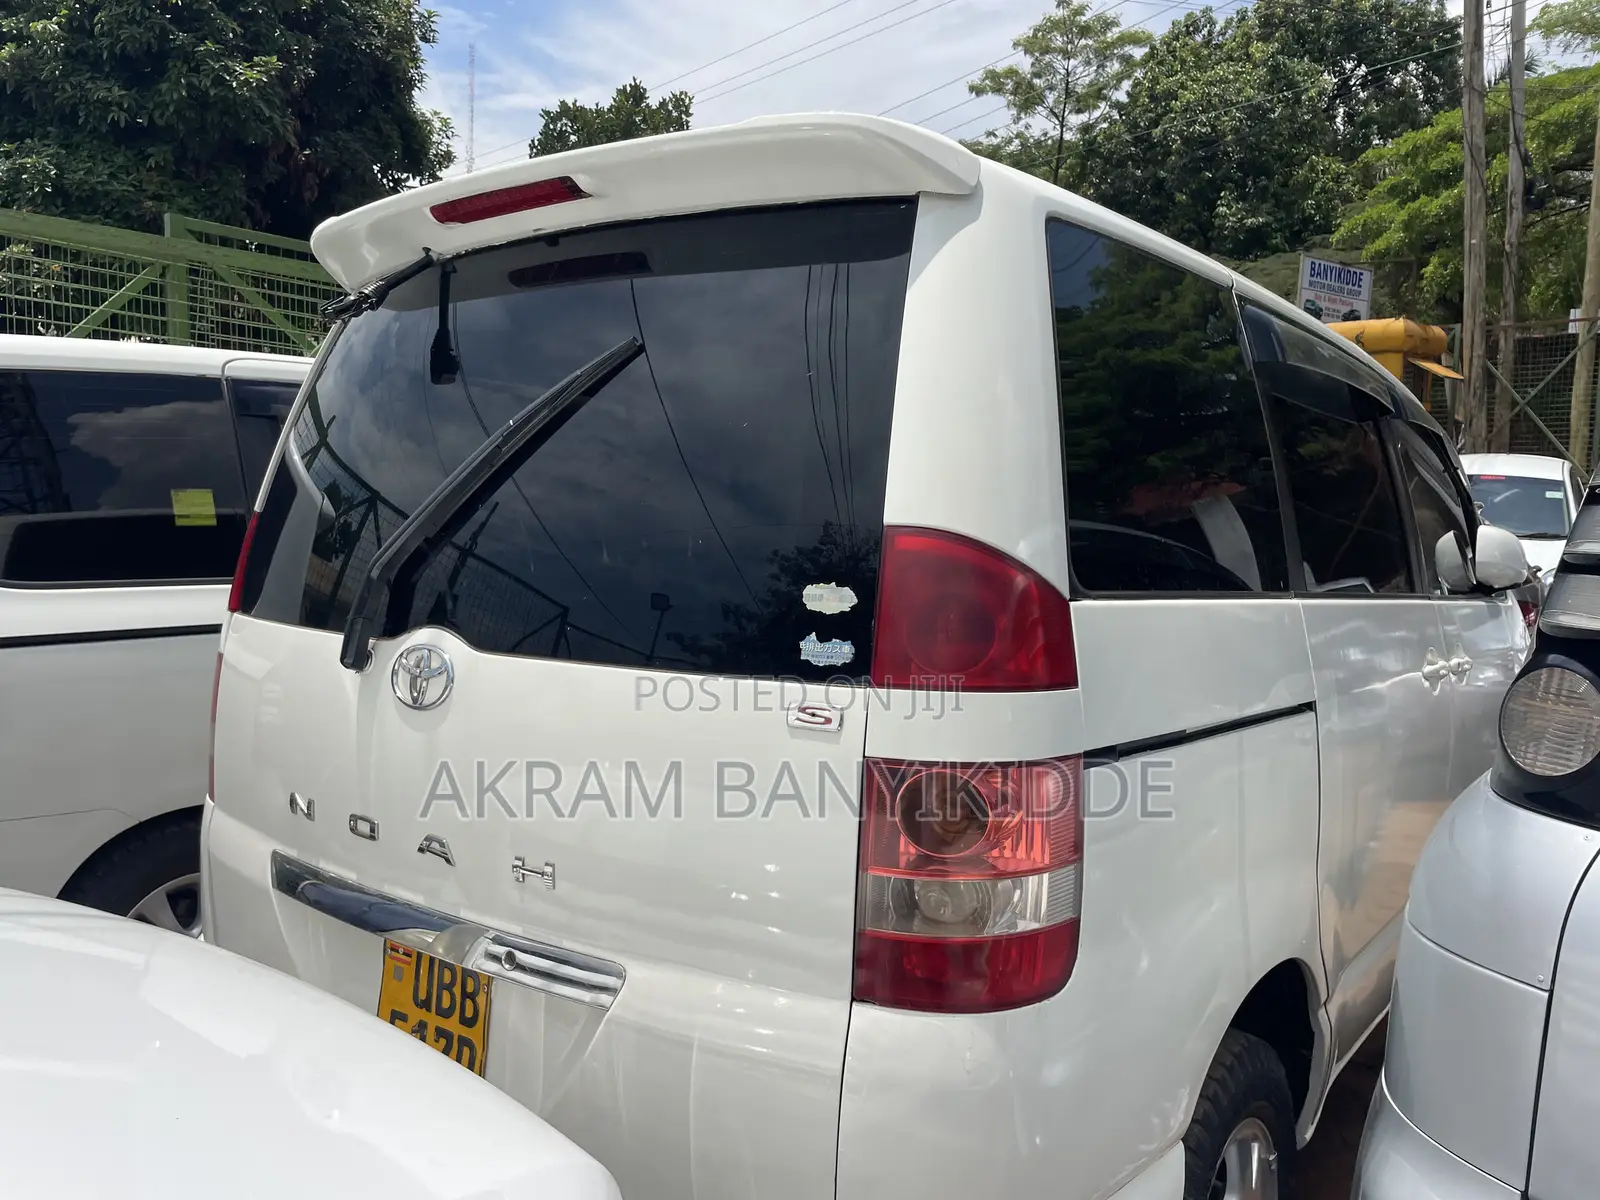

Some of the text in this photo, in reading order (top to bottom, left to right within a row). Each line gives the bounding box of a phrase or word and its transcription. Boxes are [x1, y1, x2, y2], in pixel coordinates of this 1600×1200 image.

[1308, 279, 1362, 298] MOTOR DEALERS GROUP
[1309, 261, 1364, 288] BANYIKIDDE
[289, 791, 556, 891] NOAH
[412, 950, 481, 1028] UBB
